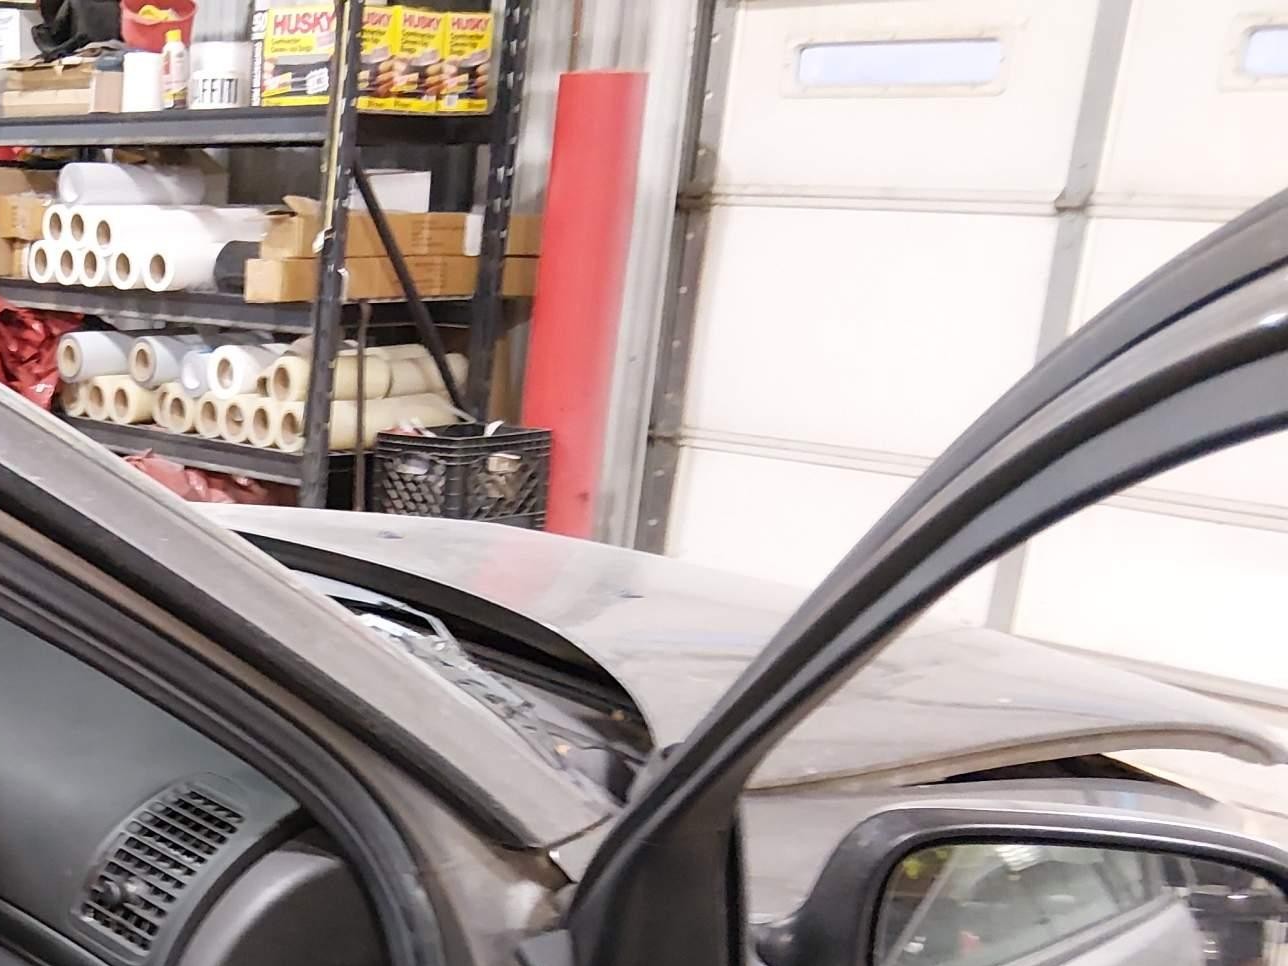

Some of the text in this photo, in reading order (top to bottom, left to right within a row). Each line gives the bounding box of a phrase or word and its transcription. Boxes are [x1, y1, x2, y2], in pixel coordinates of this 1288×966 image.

[273, 12, 335, 35] HUSKY
[403, 12, 440, 30] HUSKY
[193, 78, 239, 104] FFITI
